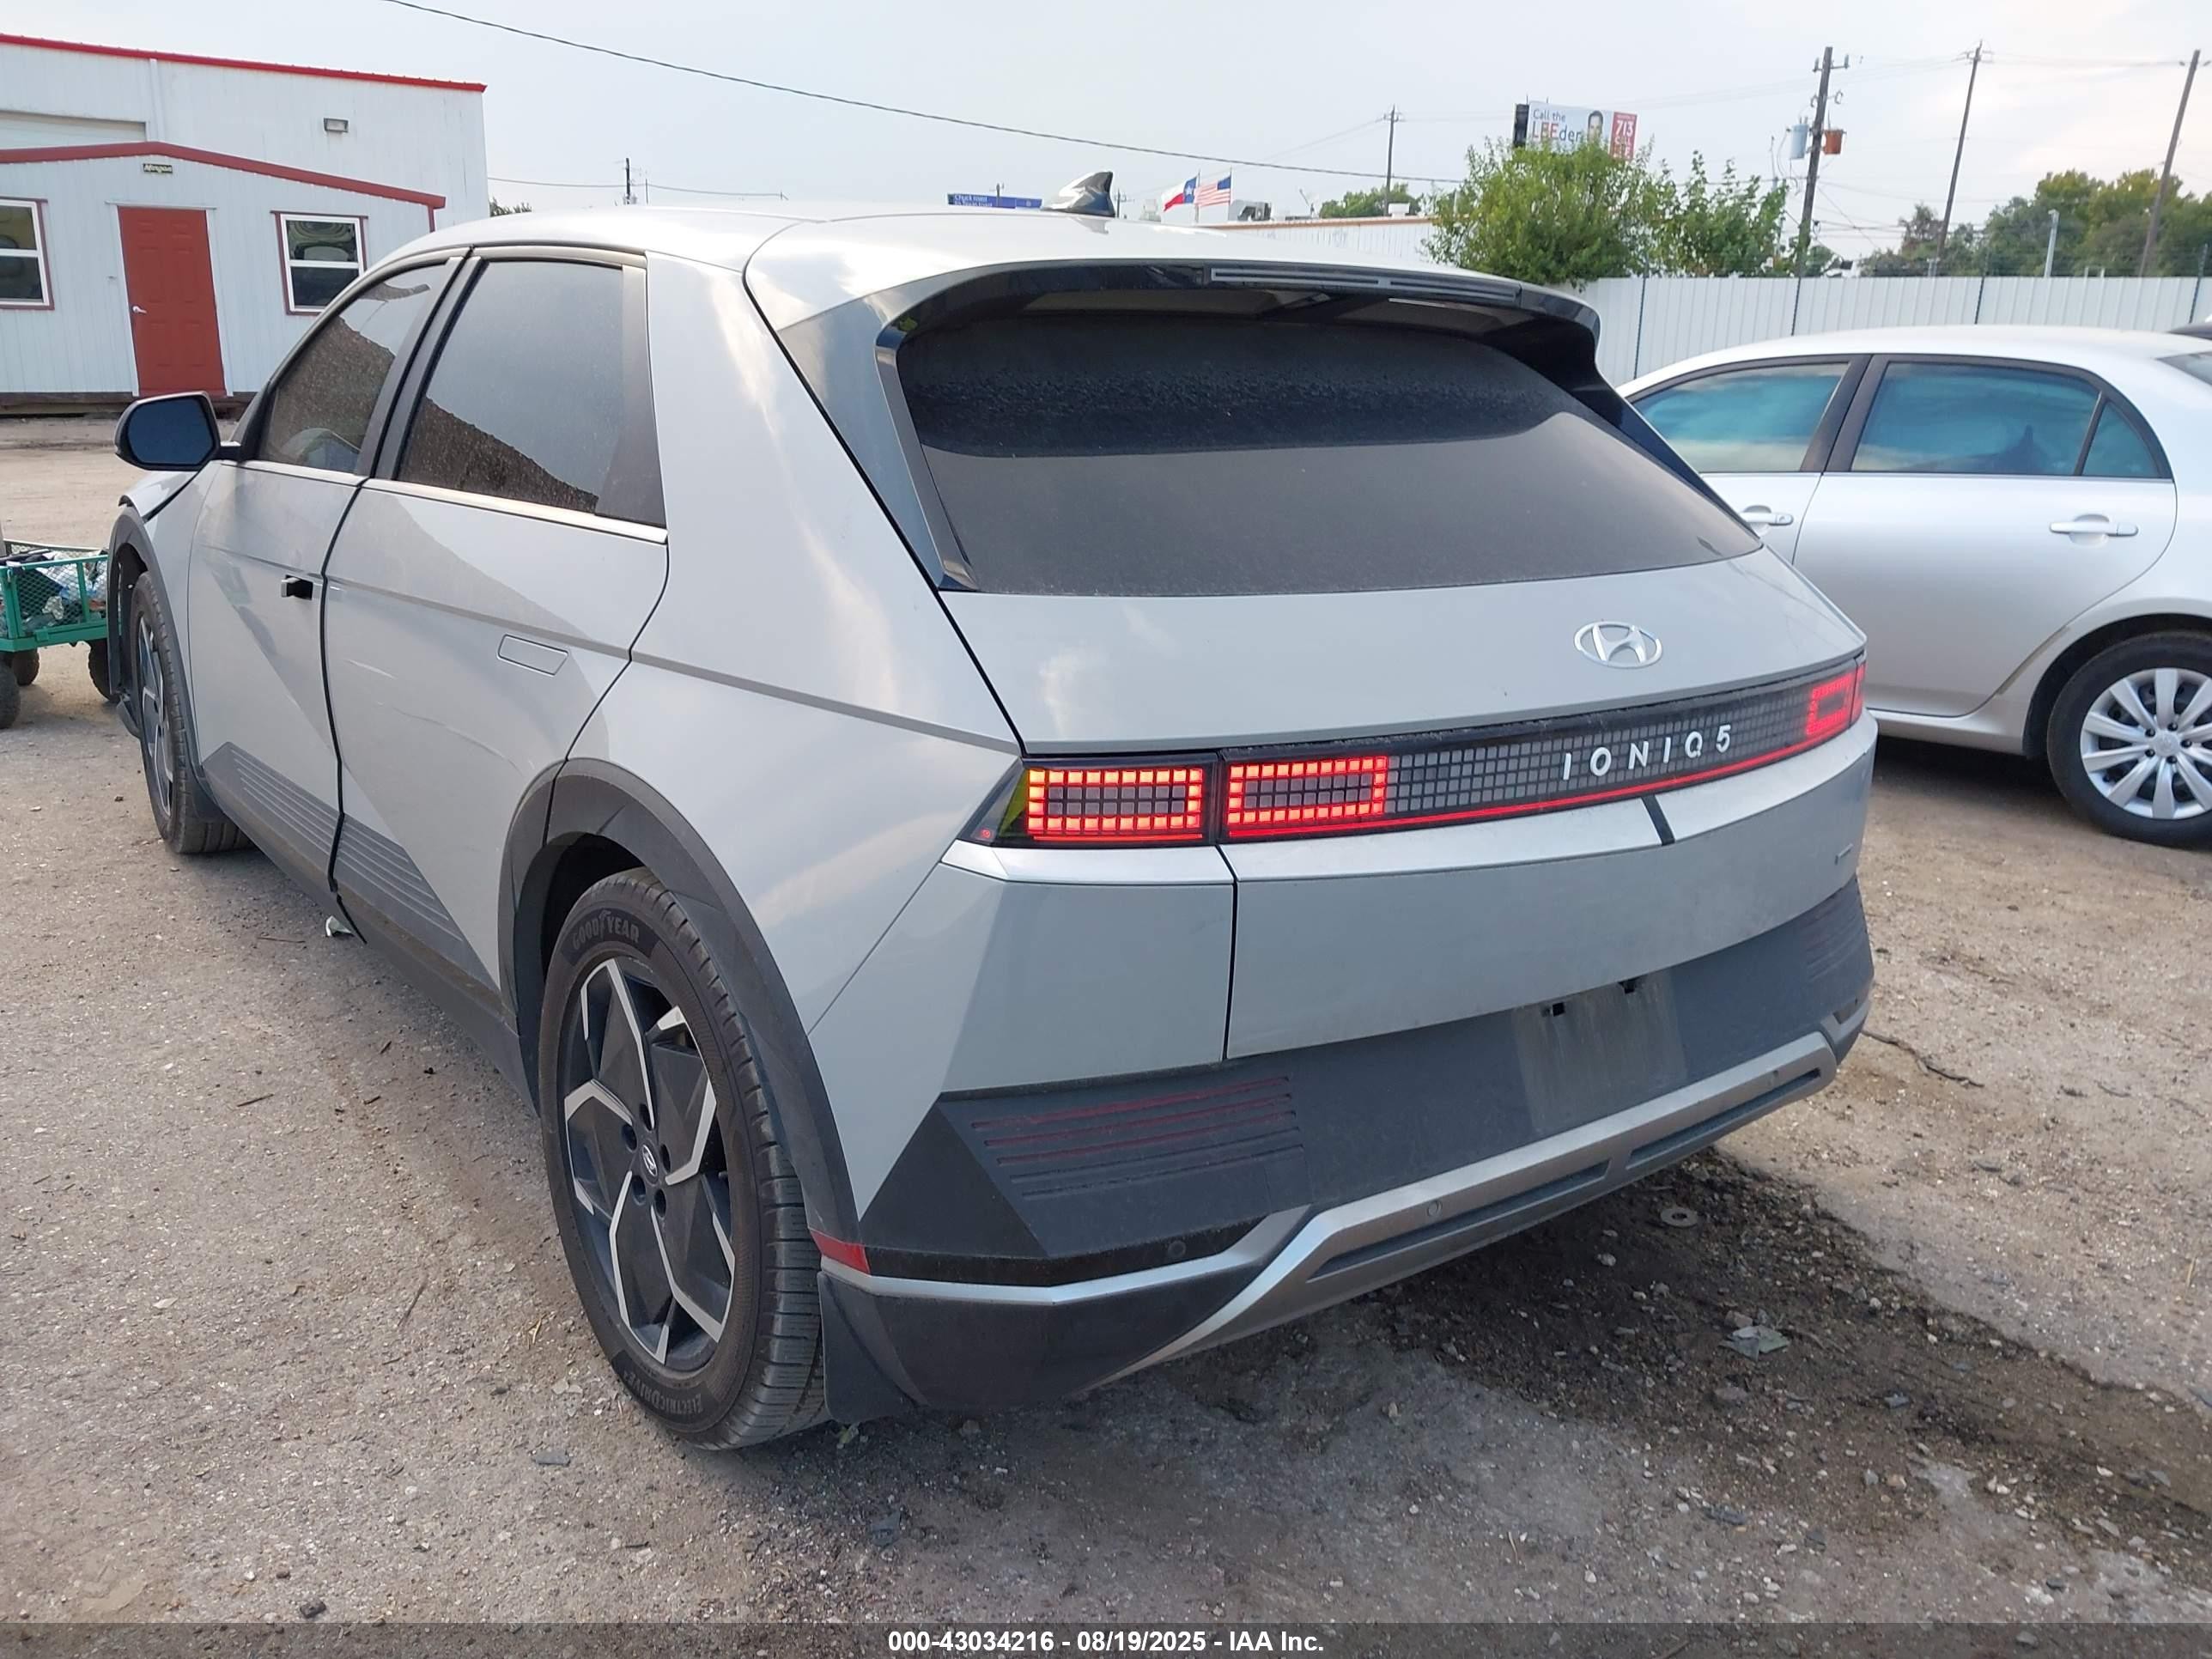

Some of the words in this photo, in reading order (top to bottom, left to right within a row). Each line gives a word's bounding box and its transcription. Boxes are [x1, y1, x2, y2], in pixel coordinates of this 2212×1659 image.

[1533, 108, 1550, 120] Call
[1553, 111, 1565, 122] the
[1616, 119, 1634, 137] 713
